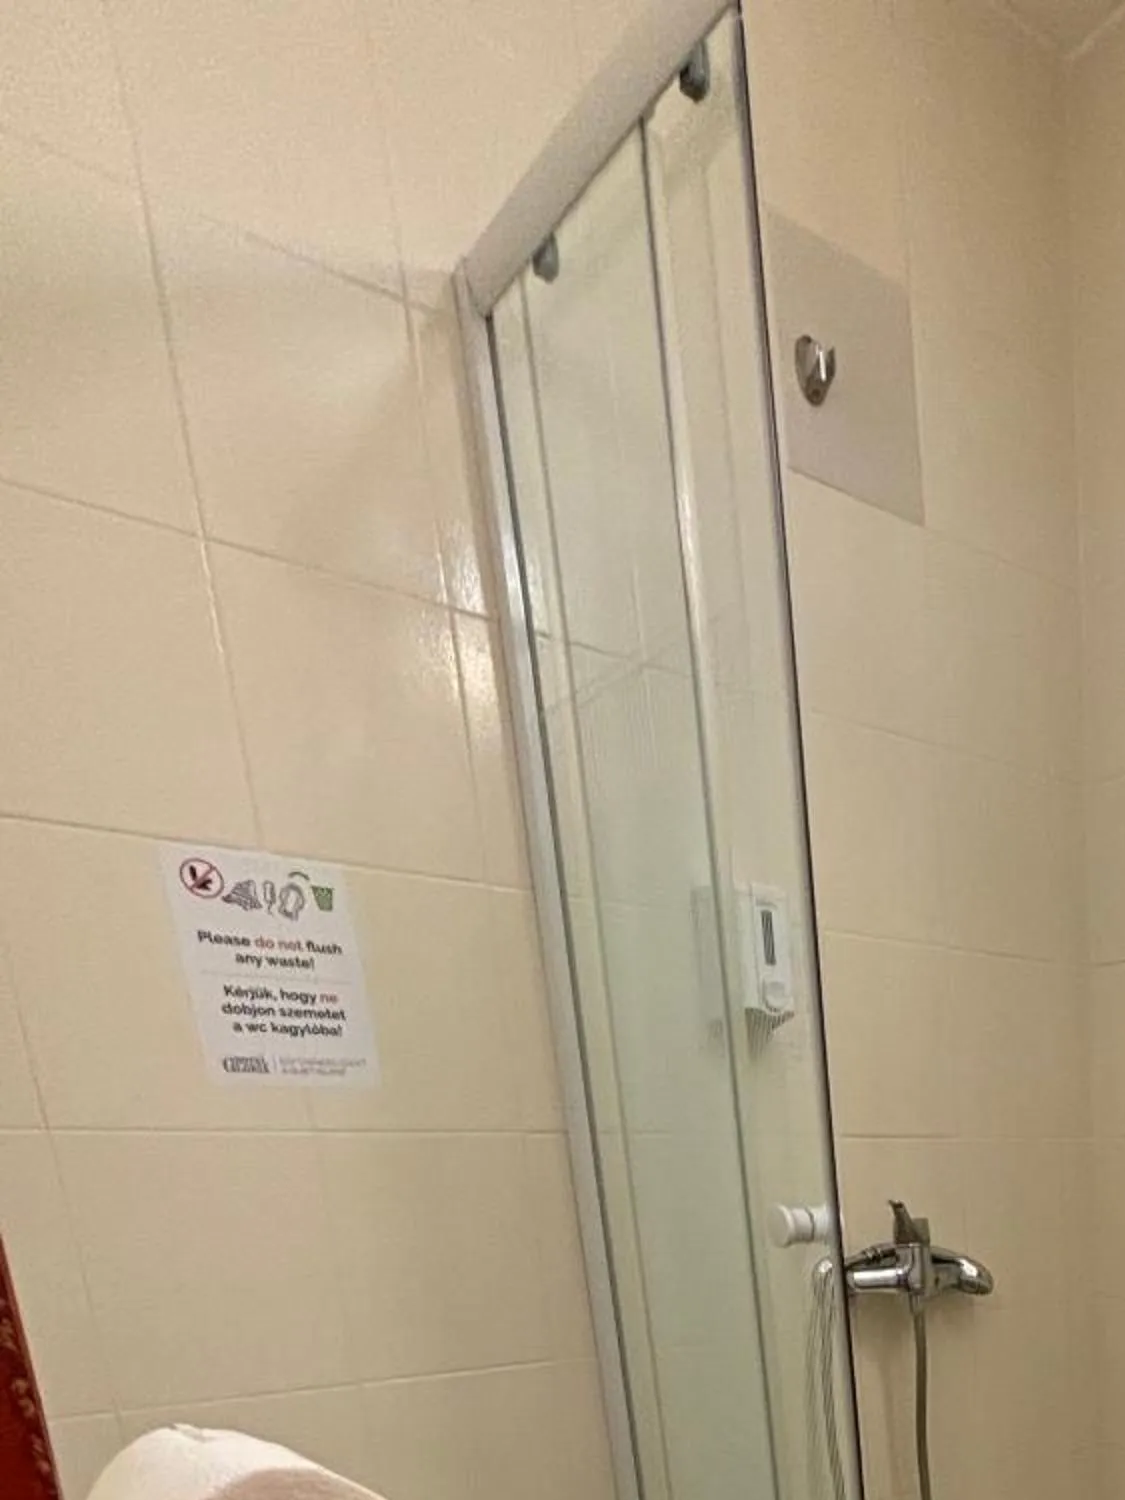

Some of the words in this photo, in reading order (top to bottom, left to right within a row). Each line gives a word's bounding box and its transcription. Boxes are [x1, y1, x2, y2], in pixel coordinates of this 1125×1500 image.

[197, 930, 251, 947] Please
[255, 935, 274, 949] do
[278, 939, 302, 952] not
[305, 940, 342, 955] flush
[235, 952, 261, 967] any
[266, 956, 315, 970] waste!
[279, 988, 317, 1006] hogy
[320, 992, 338, 1003] ne
[221, 1003, 275, 1018] dobjon
[279, 1007, 347, 1020] szemetet
[233, 1023, 243, 1033] a
[246, 1022, 266, 1033] wc
